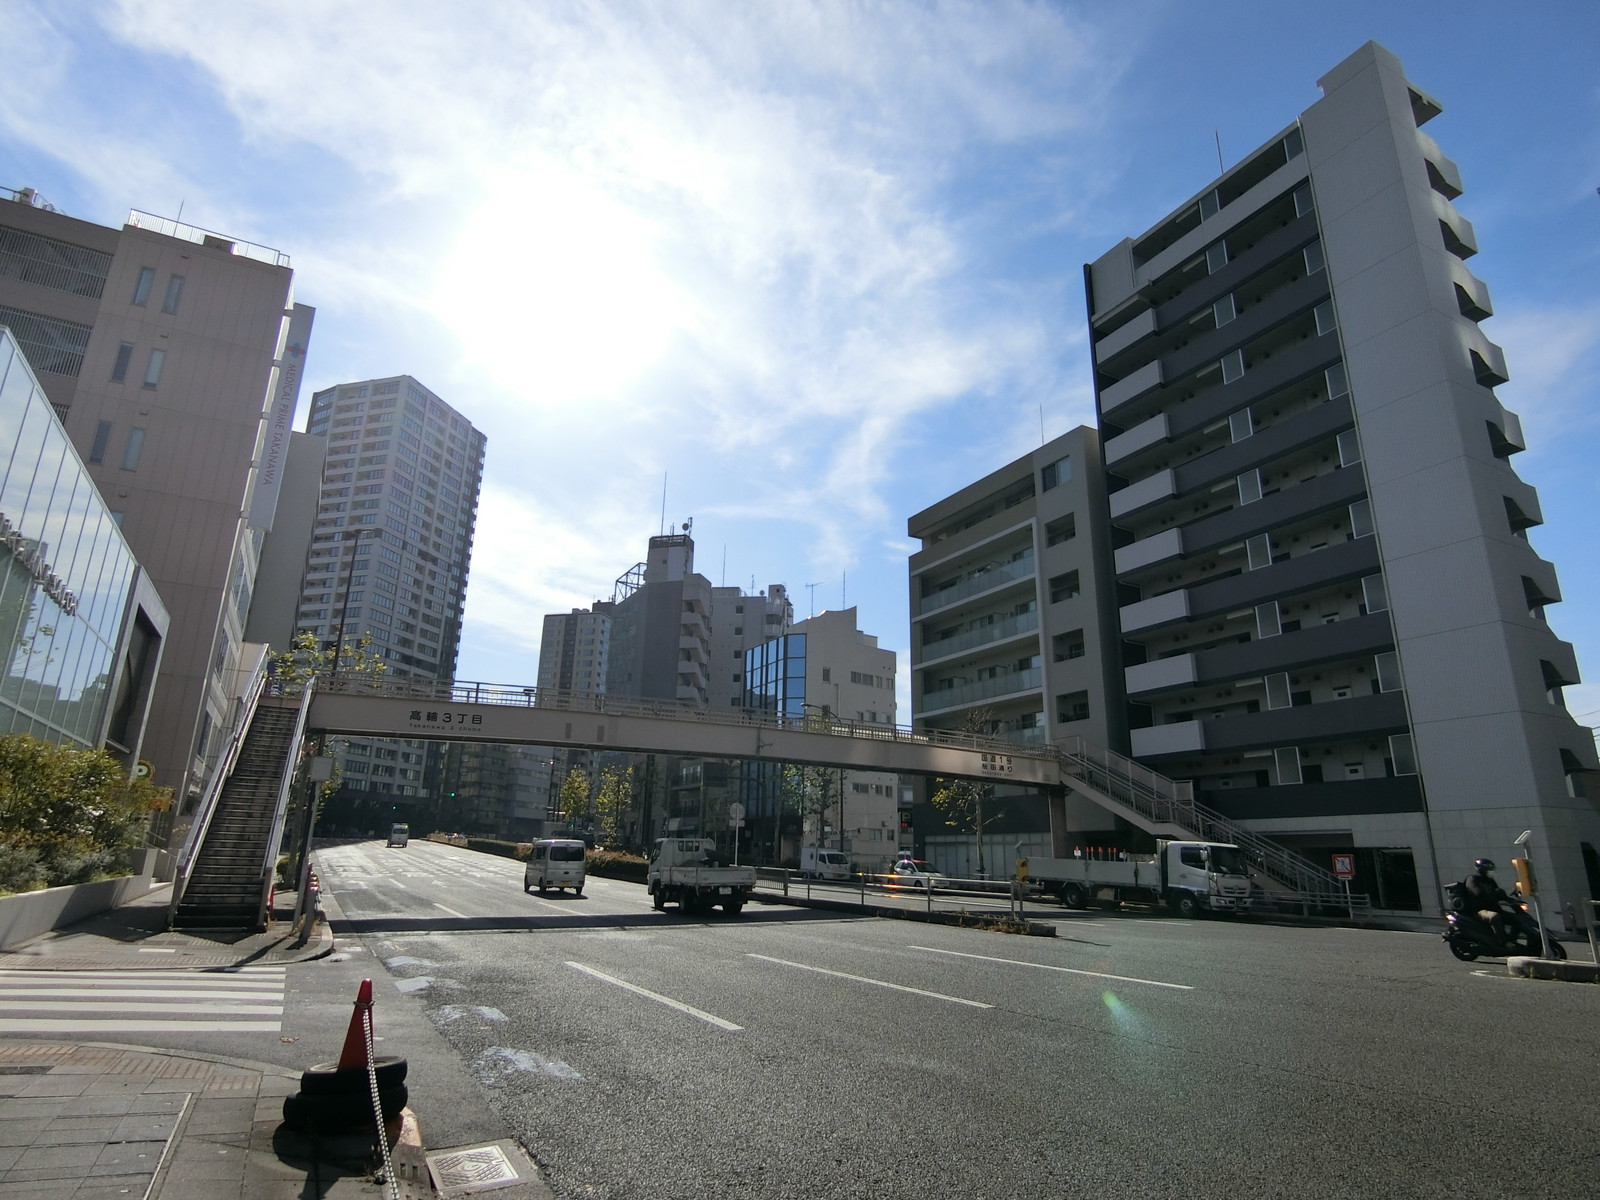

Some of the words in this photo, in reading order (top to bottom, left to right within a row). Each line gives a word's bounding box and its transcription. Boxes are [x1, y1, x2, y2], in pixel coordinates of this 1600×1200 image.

[282, 363, 297, 404] MEDICAL
[274, 404, 289, 430] PRIME
[263, 431, 283, 486] TAKANAWA
[409, 710, 482, 725] 高輪3丁目
[982, 754, 1012, 765] 国道1号
[982, 763, 1013, 772] 桜田通り
